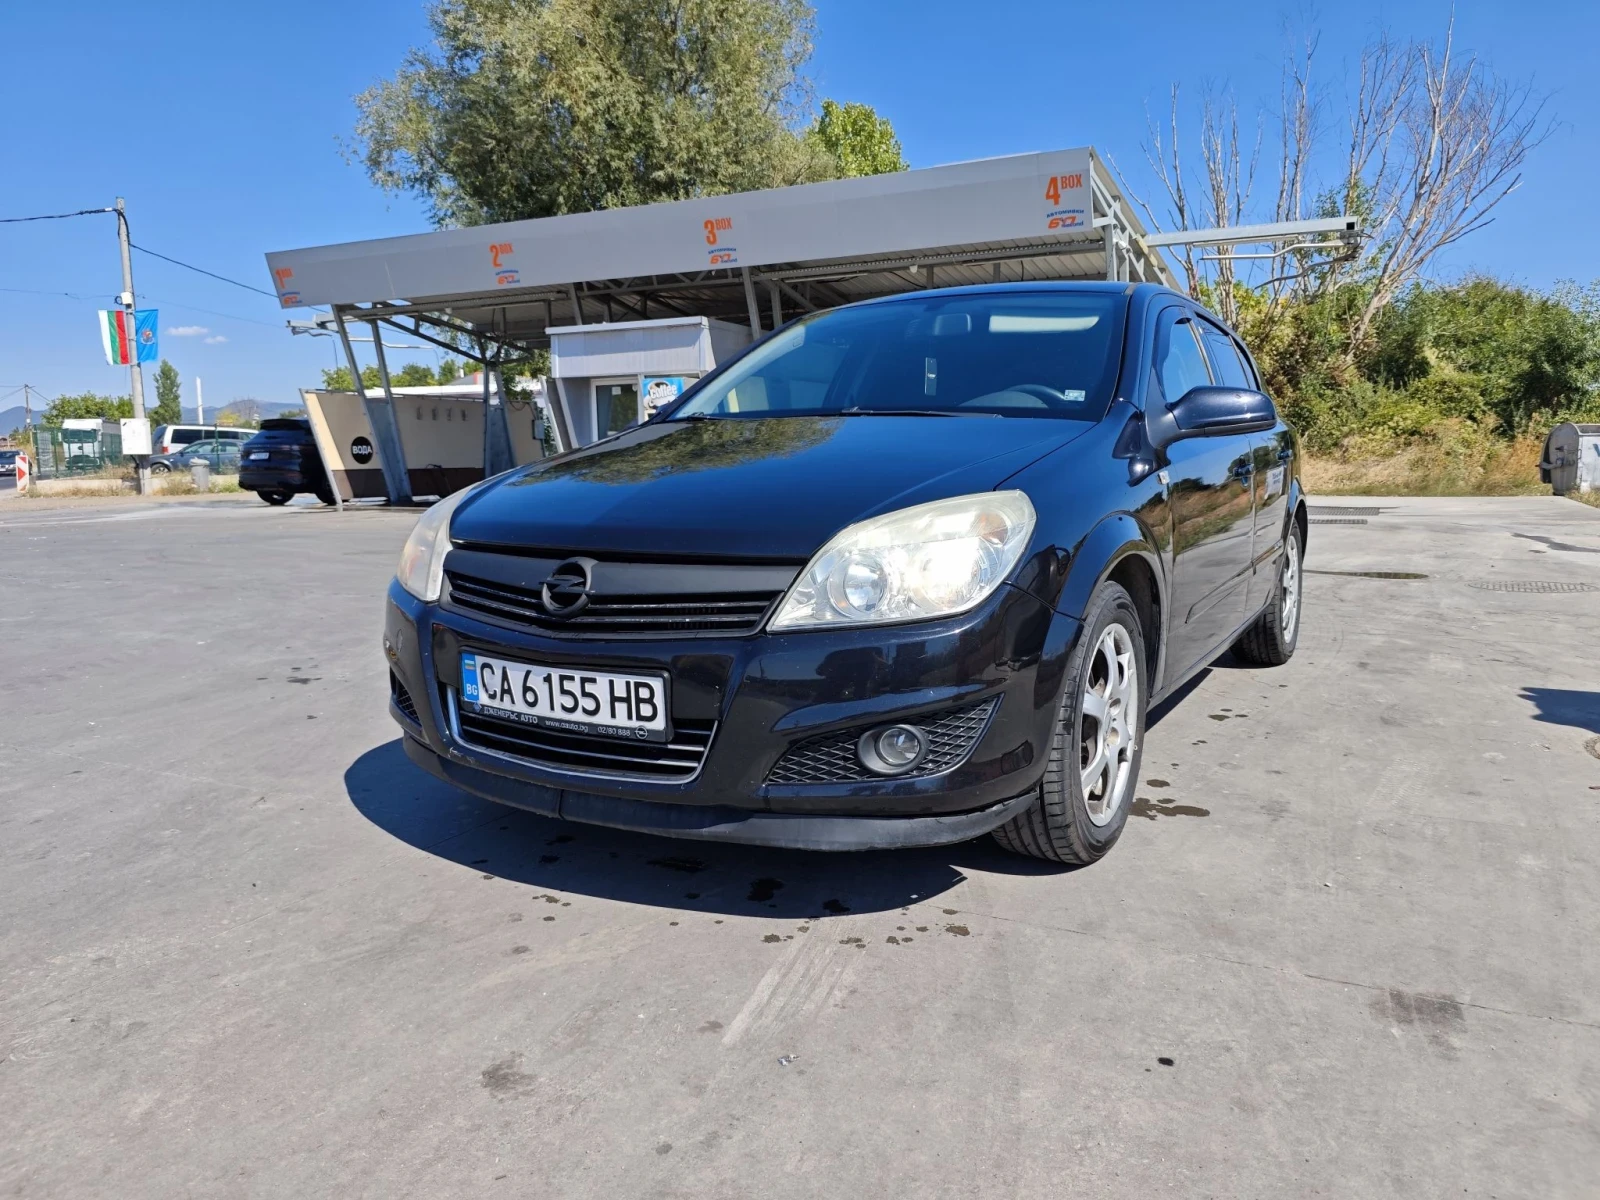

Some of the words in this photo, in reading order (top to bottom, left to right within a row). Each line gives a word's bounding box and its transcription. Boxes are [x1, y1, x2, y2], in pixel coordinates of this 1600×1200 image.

[1045, 176, 1060, 206] 4
[1060, 174, 1083, 190] BOX
[704, 219, 717, 245] 3
[715, 217, 732, 230] BOX
[490, 244, 503, 268] 2
[352, 445, 373, 455] ВОДА
[466, 684, 478, 696] BG
[480, 662, 515, 704] CA
[522, 670, 601, 716] 6155
[608, 679, 658, 723] HB
[520, 714, 538, 724] АУТО
